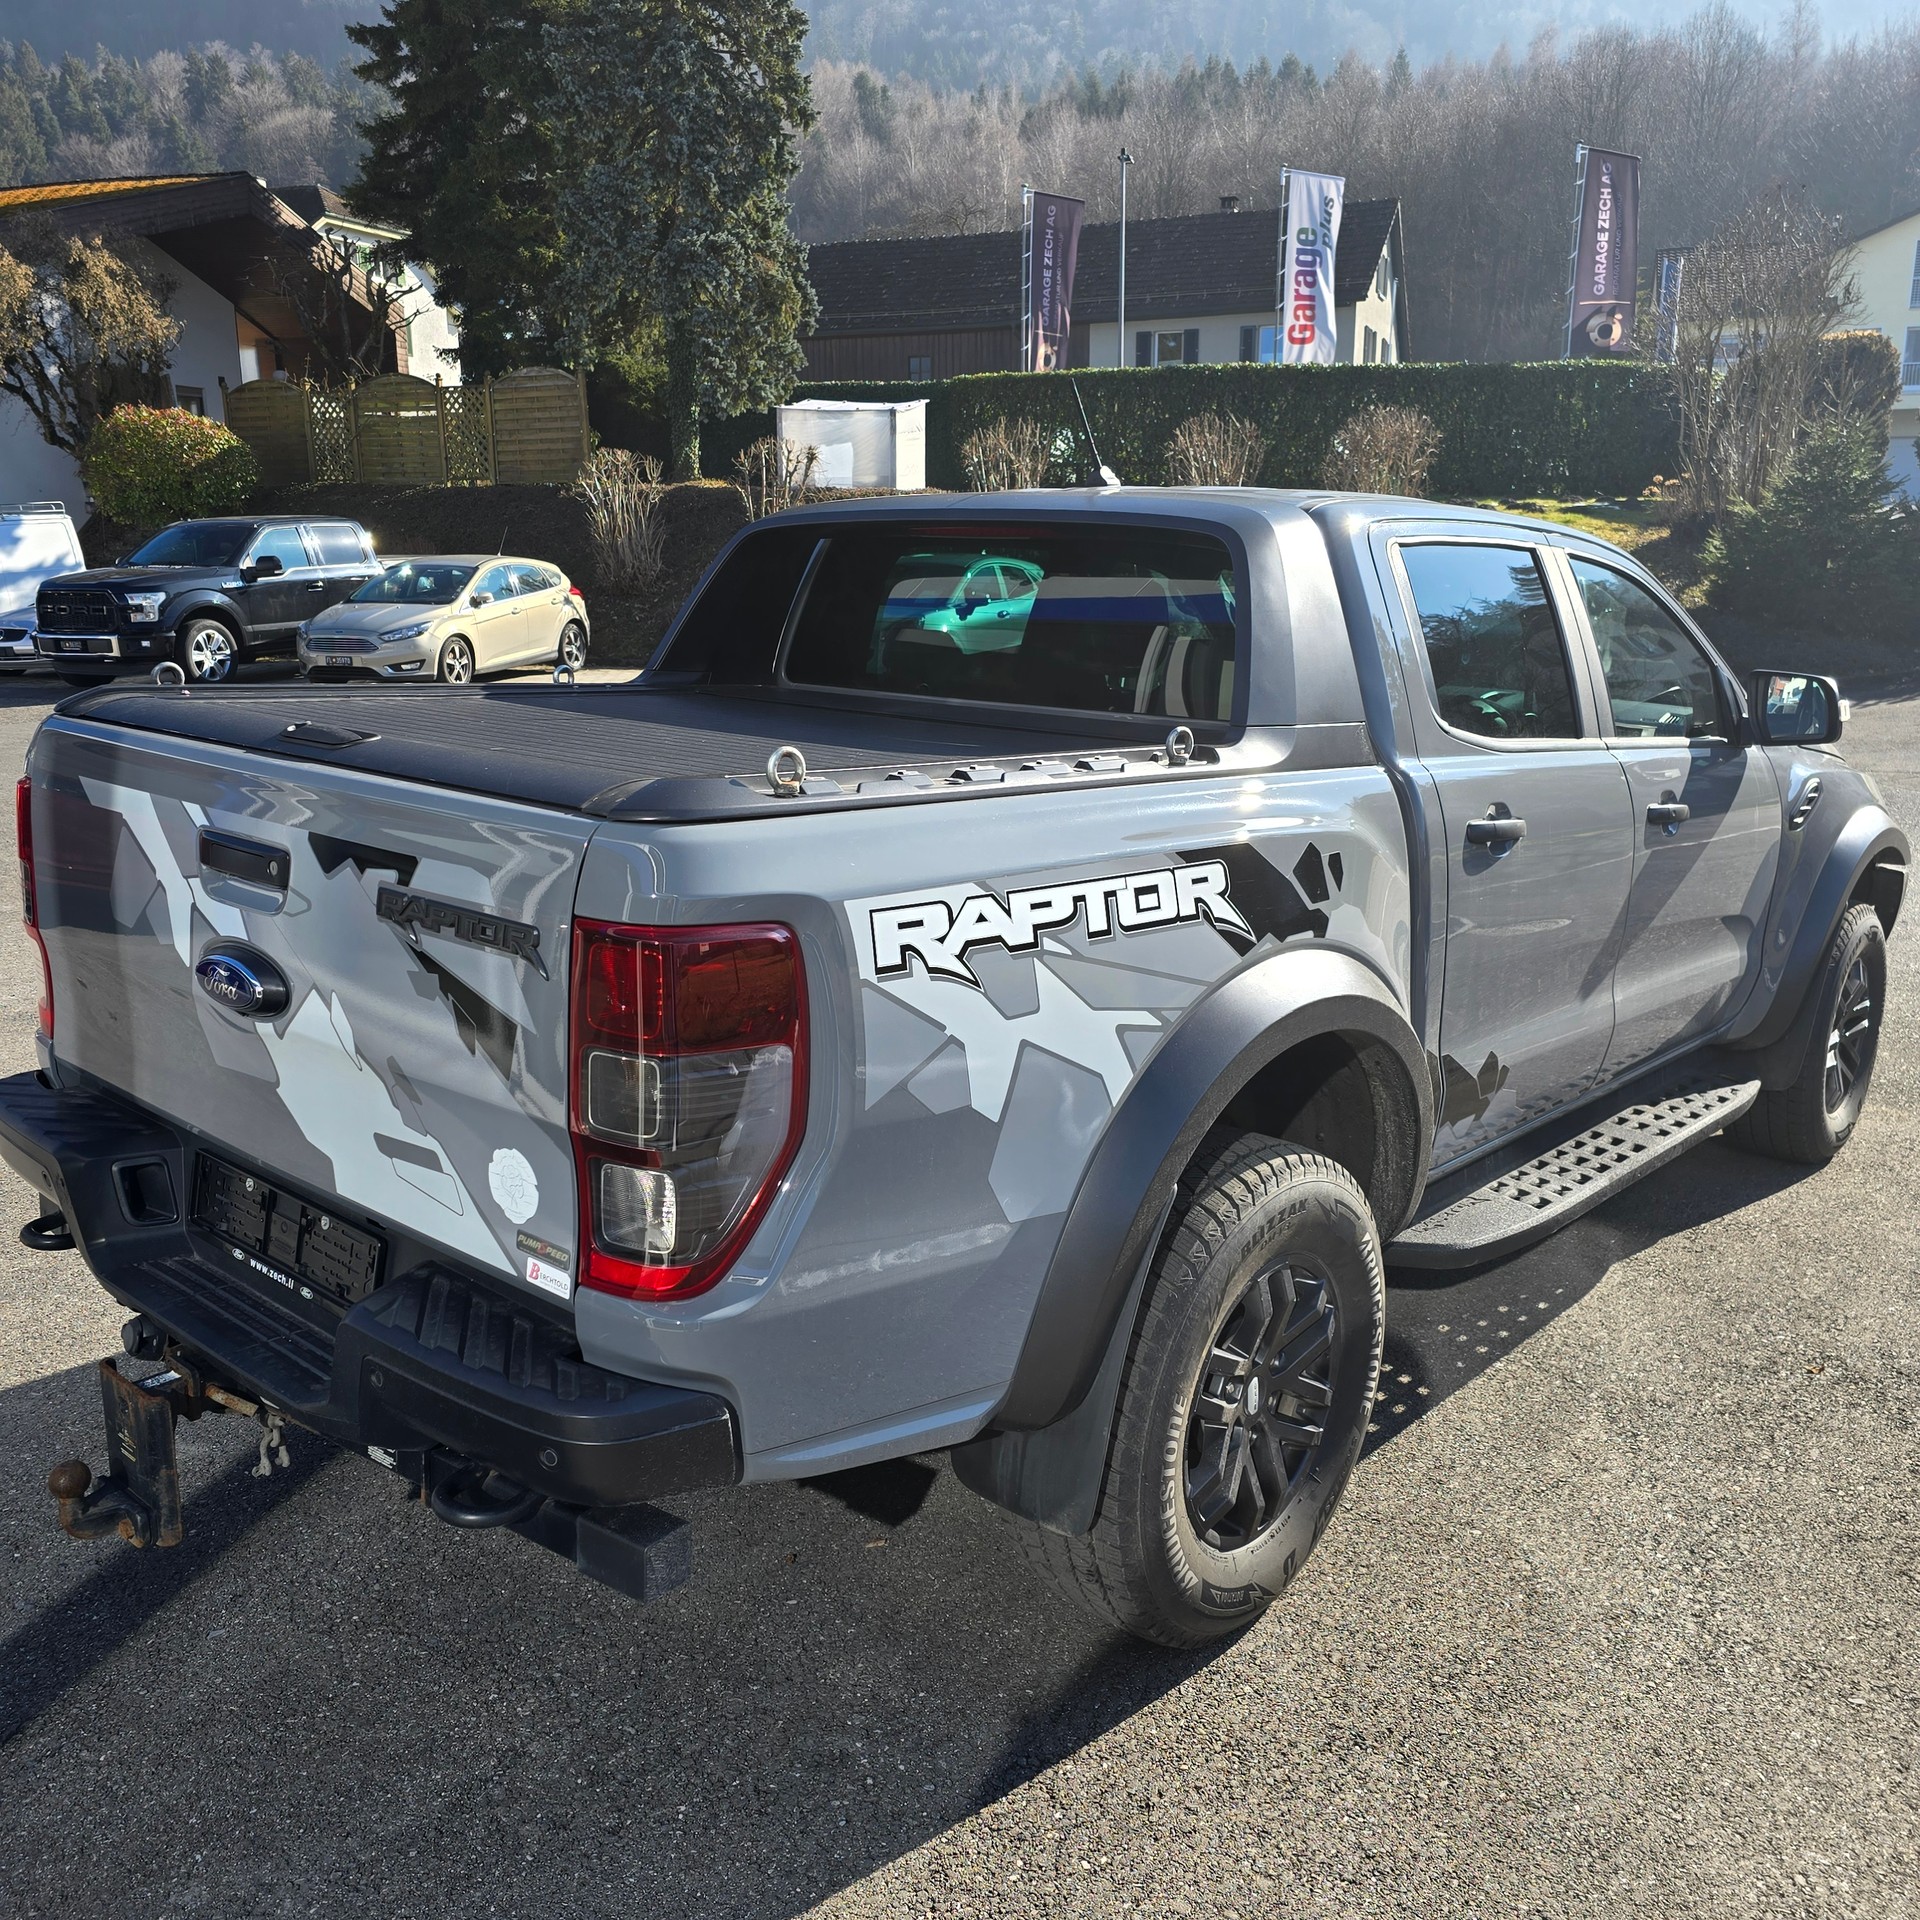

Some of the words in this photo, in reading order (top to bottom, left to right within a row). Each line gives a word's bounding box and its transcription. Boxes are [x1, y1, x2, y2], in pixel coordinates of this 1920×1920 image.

[1601, 161, 1612, 184] AG
[1047, 204, 1057, 227] AG
[1319, 195, 1335, 251] plus
[1598, 188, 1612, 229] ZECH
[1044, 229, 1054, 267] ZECH
[1593, 232, 1609, 296] GARAGE
[1042, 268, 1053, 327] GARAGE
[1287, 226, 1323, 345] Garage
[376, 885, 550, 982] RAPTOR
[869, 858, 1257, 990] RAPTOR
[204, 964, 239, 1000] Ford
[529, 1261, 568, 1291] BERCHTOLD
[1357, 1231, 1384, 1417] BRIDGESTONE
[1159, 1392, 1200, 1599] BRIDGESTONE
